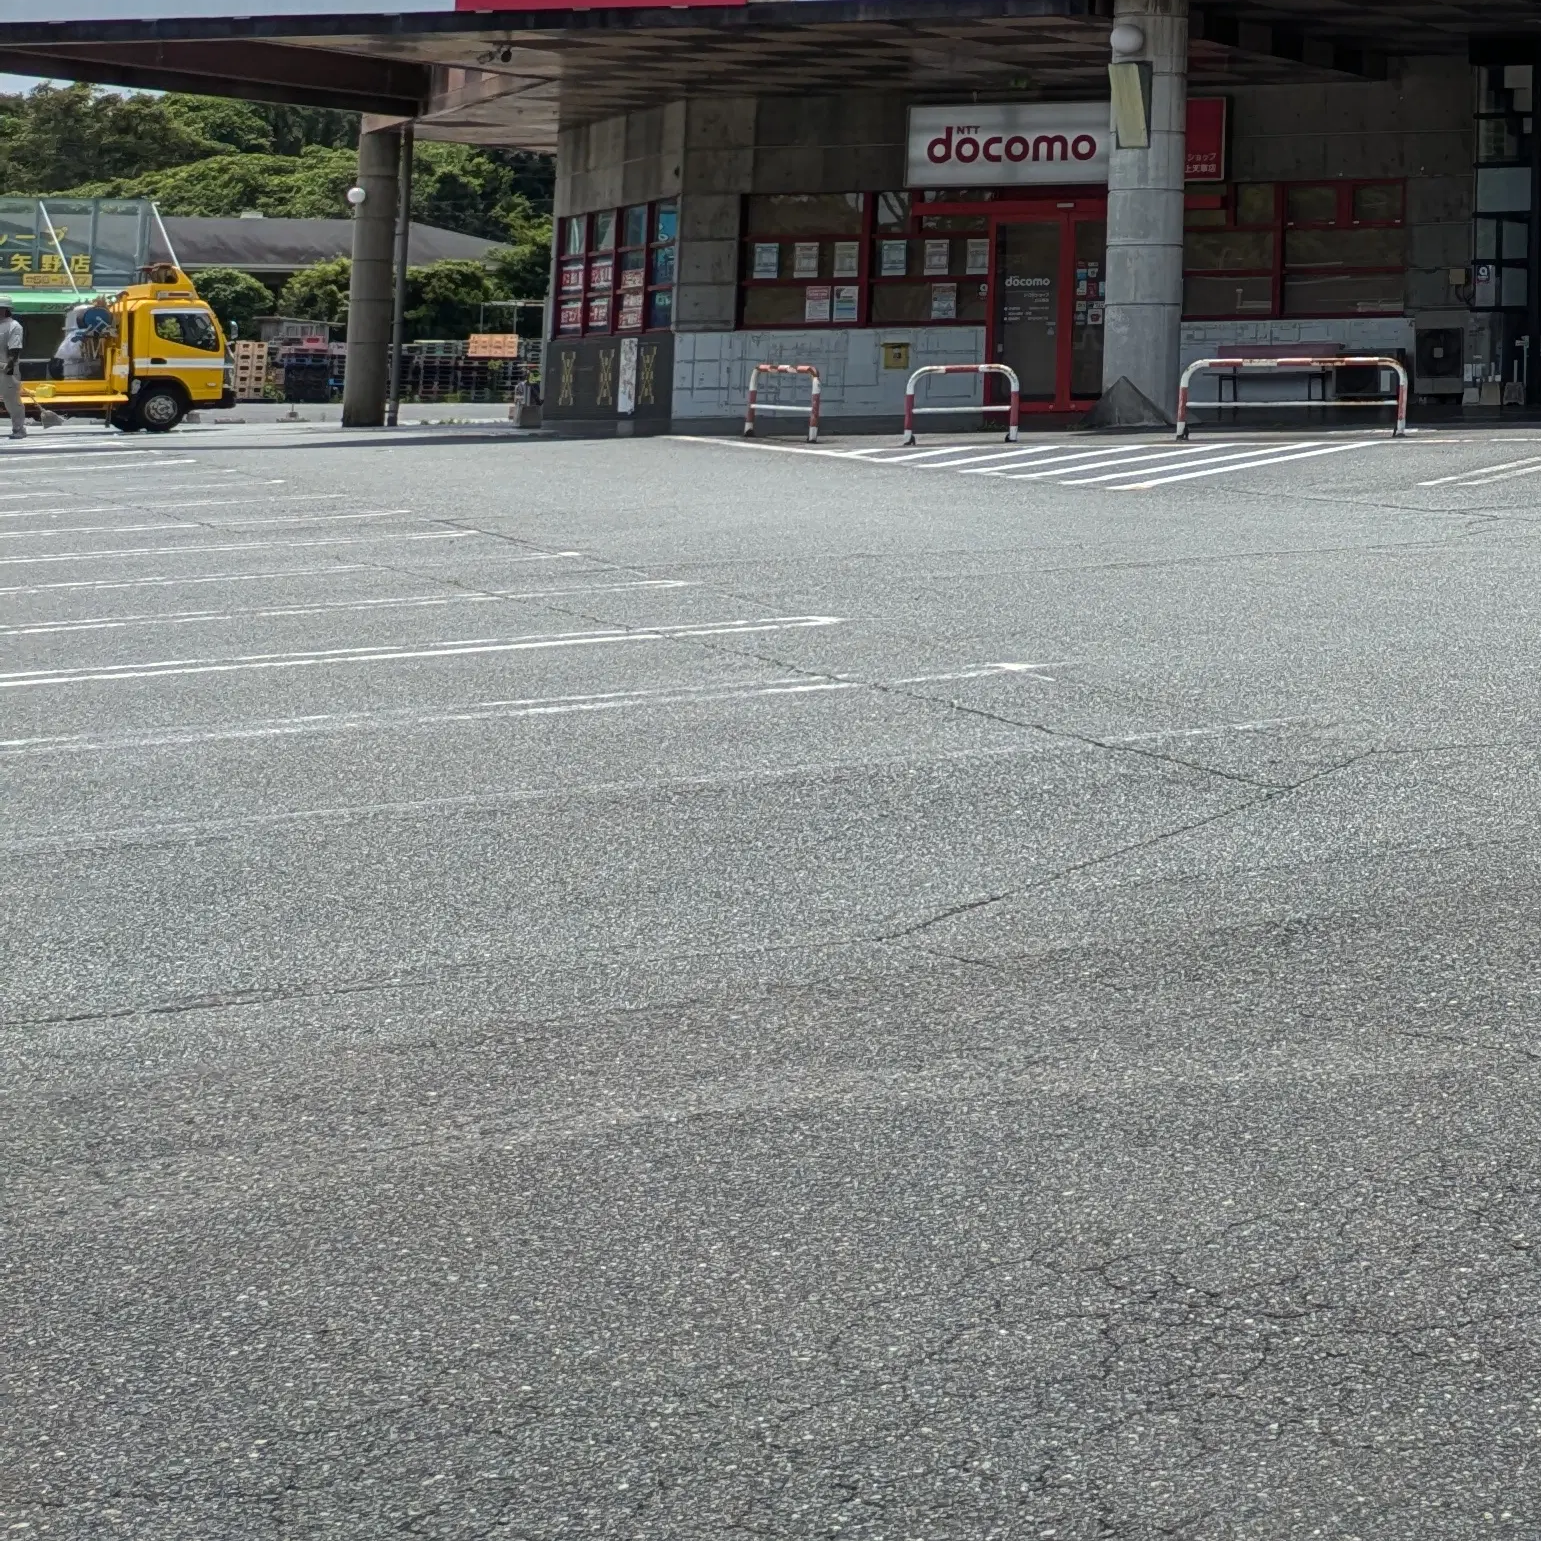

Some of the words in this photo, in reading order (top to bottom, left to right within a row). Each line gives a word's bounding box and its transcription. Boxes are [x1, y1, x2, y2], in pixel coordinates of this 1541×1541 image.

[956, 126, 980, 135] NTT
[927, 126, 1097, 163] docomo
[1004, 276, 1050, 287] docomo
